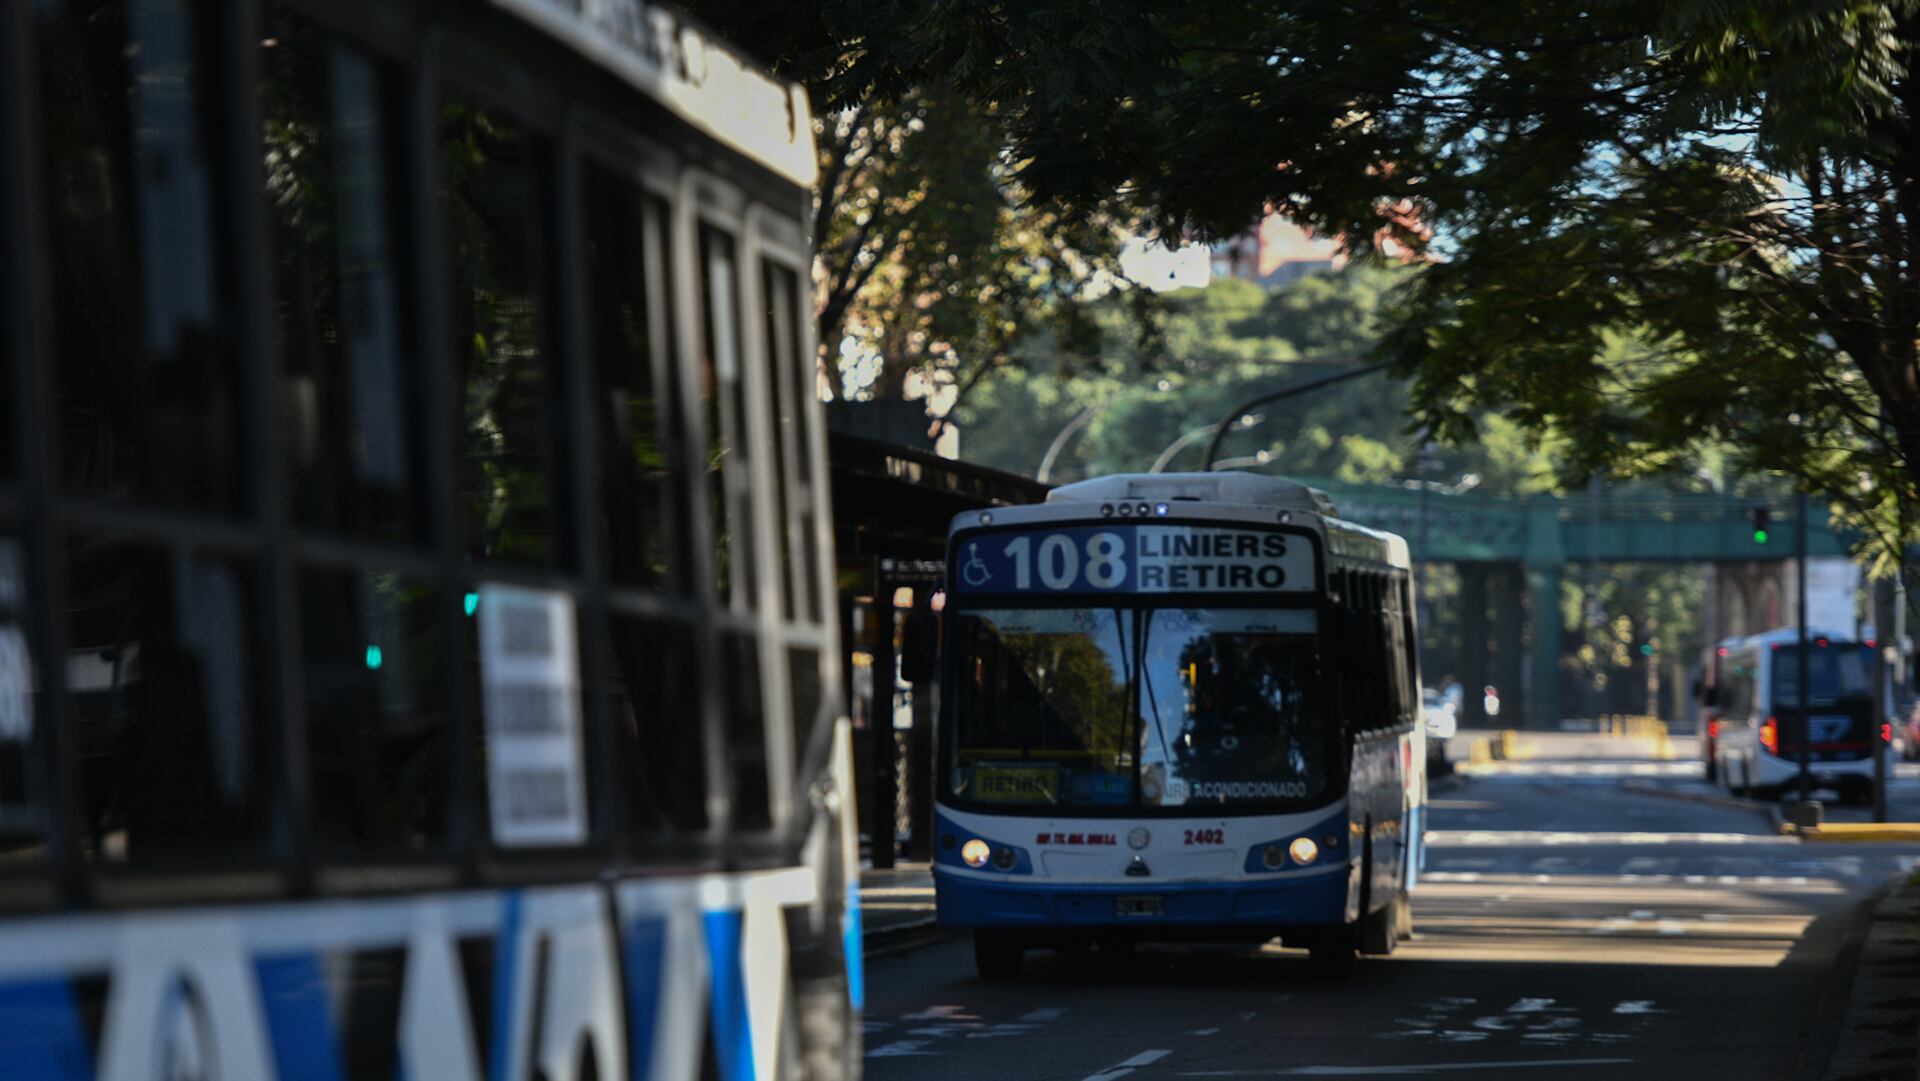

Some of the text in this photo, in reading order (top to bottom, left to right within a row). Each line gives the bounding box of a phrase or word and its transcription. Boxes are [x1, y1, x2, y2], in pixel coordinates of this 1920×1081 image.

[1139, 534, 1287, 559] LINIERS
[1003, 533, 1127, 590] 108
[1140, 564, 1286, 588] RETIRO
[1194, 781, 1307, 799] ACONDICIONADO
[1184, 830, 1224, 845] 2402
